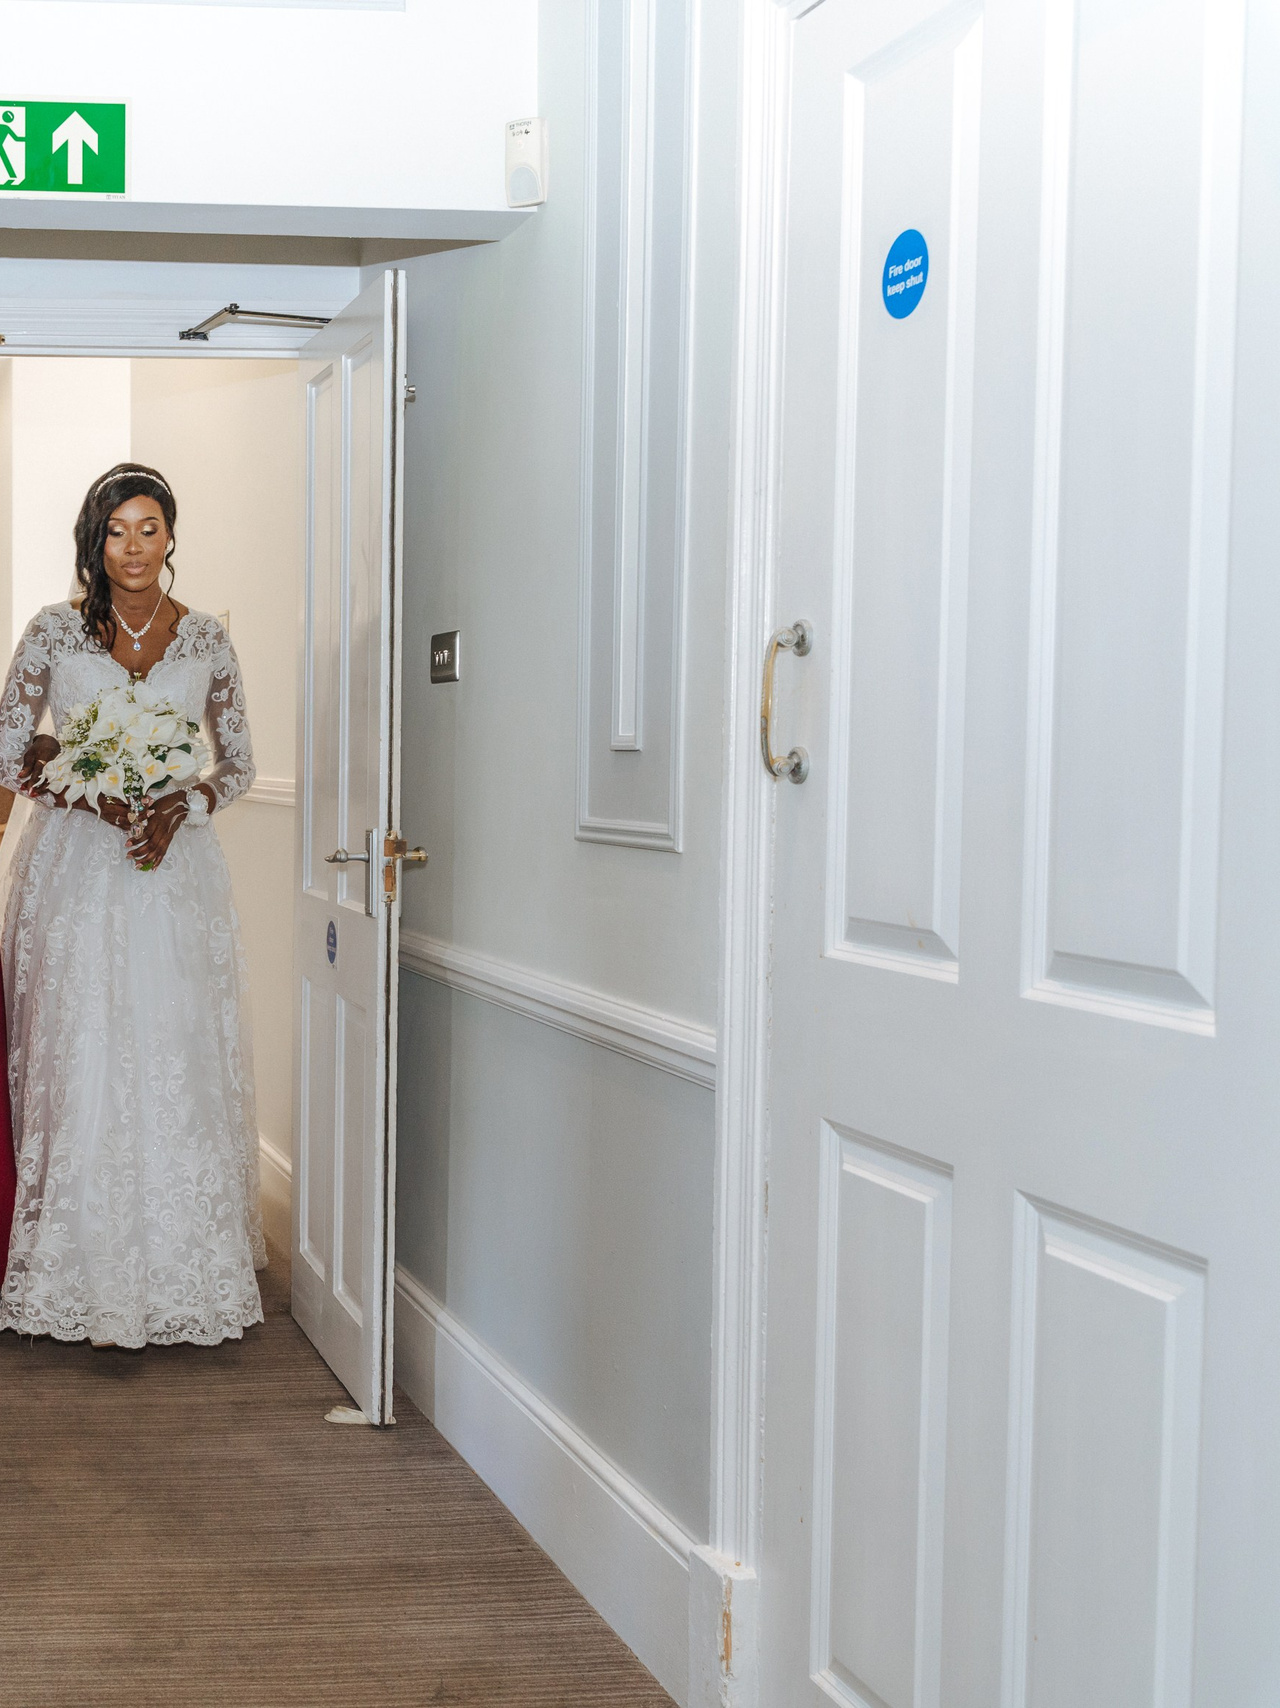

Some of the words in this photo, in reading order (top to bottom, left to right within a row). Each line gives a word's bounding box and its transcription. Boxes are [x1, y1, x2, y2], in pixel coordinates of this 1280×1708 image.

[888, 264, 903, 279] Fire
[904, 255, 923, 272] door
[887, 281, 905, 297] keep
[905, 271, 924, 289] shut
